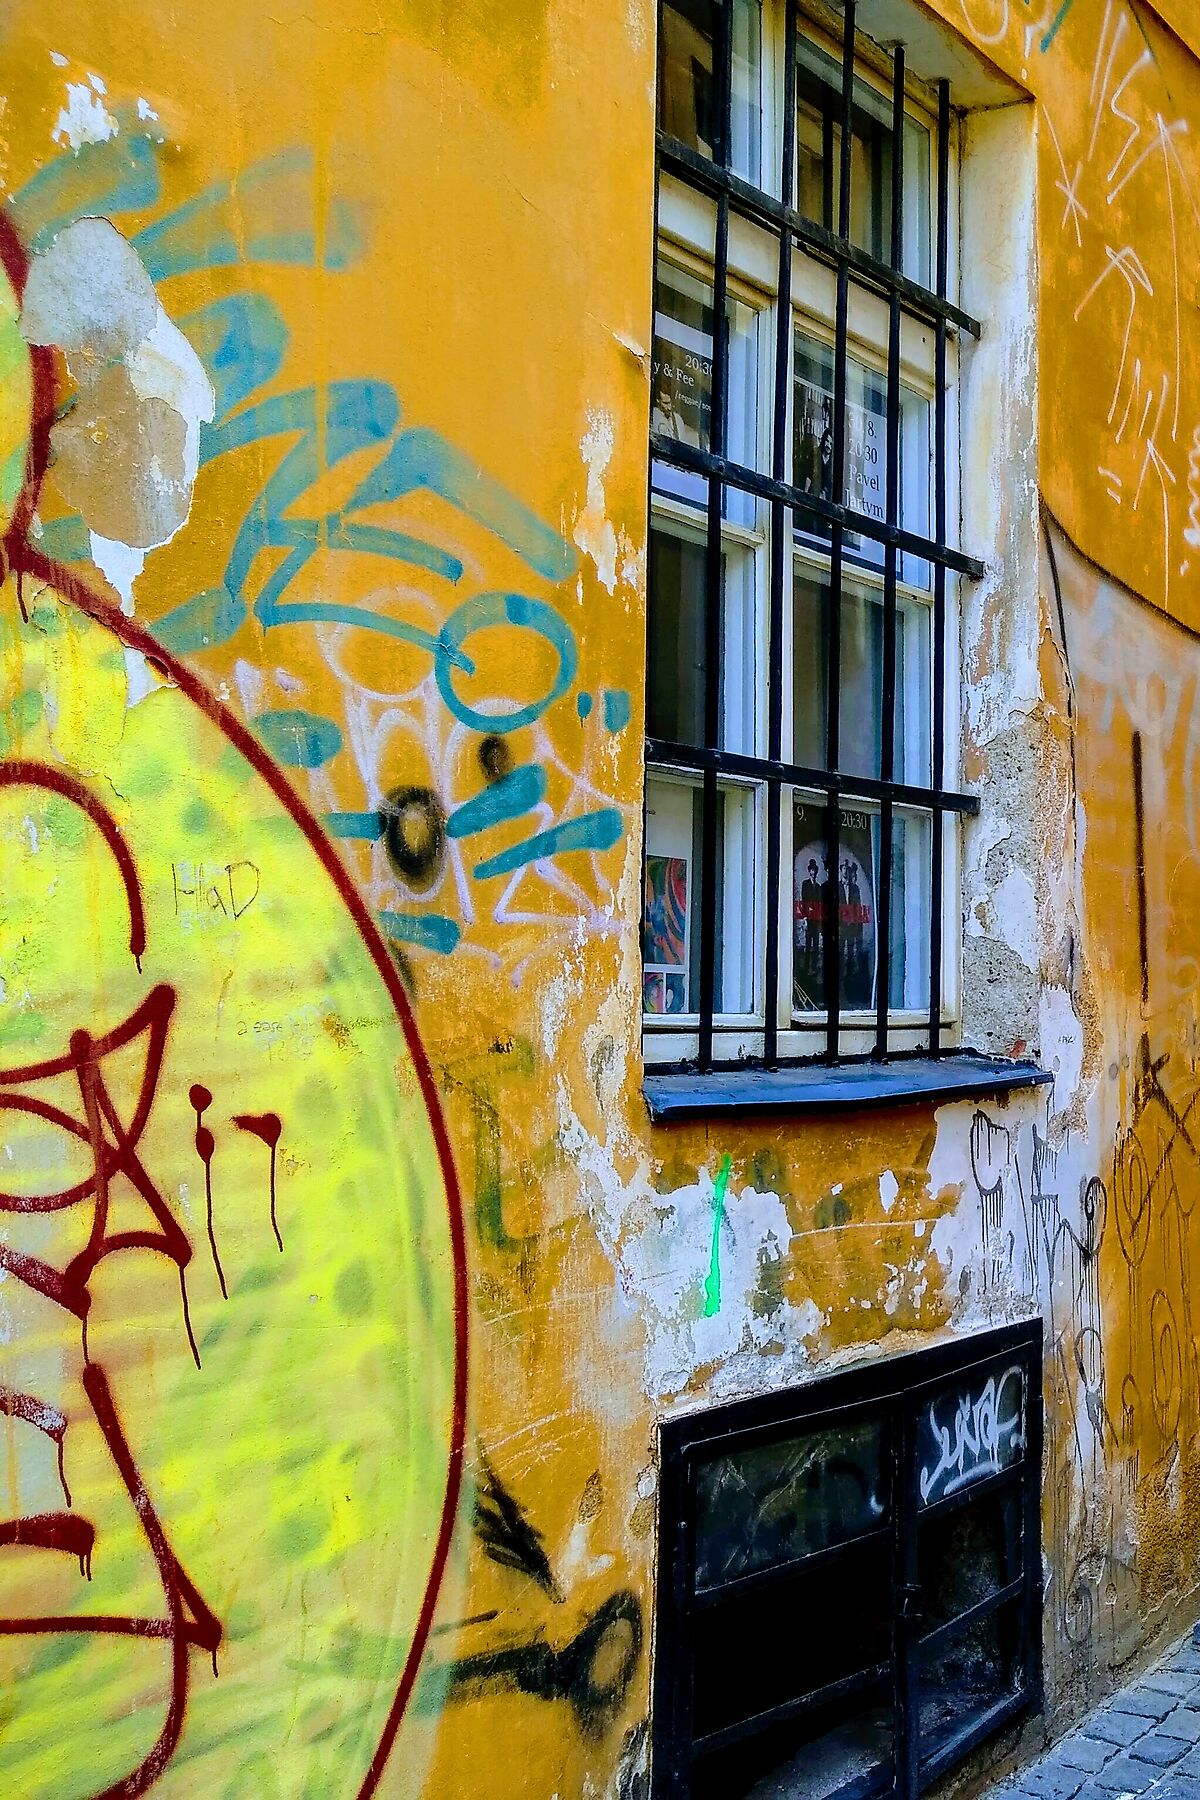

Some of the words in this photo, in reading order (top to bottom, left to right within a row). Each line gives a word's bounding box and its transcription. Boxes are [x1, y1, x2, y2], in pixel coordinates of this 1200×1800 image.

[663, 364, 673, 377] &
[676, 368, 694, 386] Fee
[848, 464, 880, 491] Pavel
[841, 811, 868, 830] 20:30
